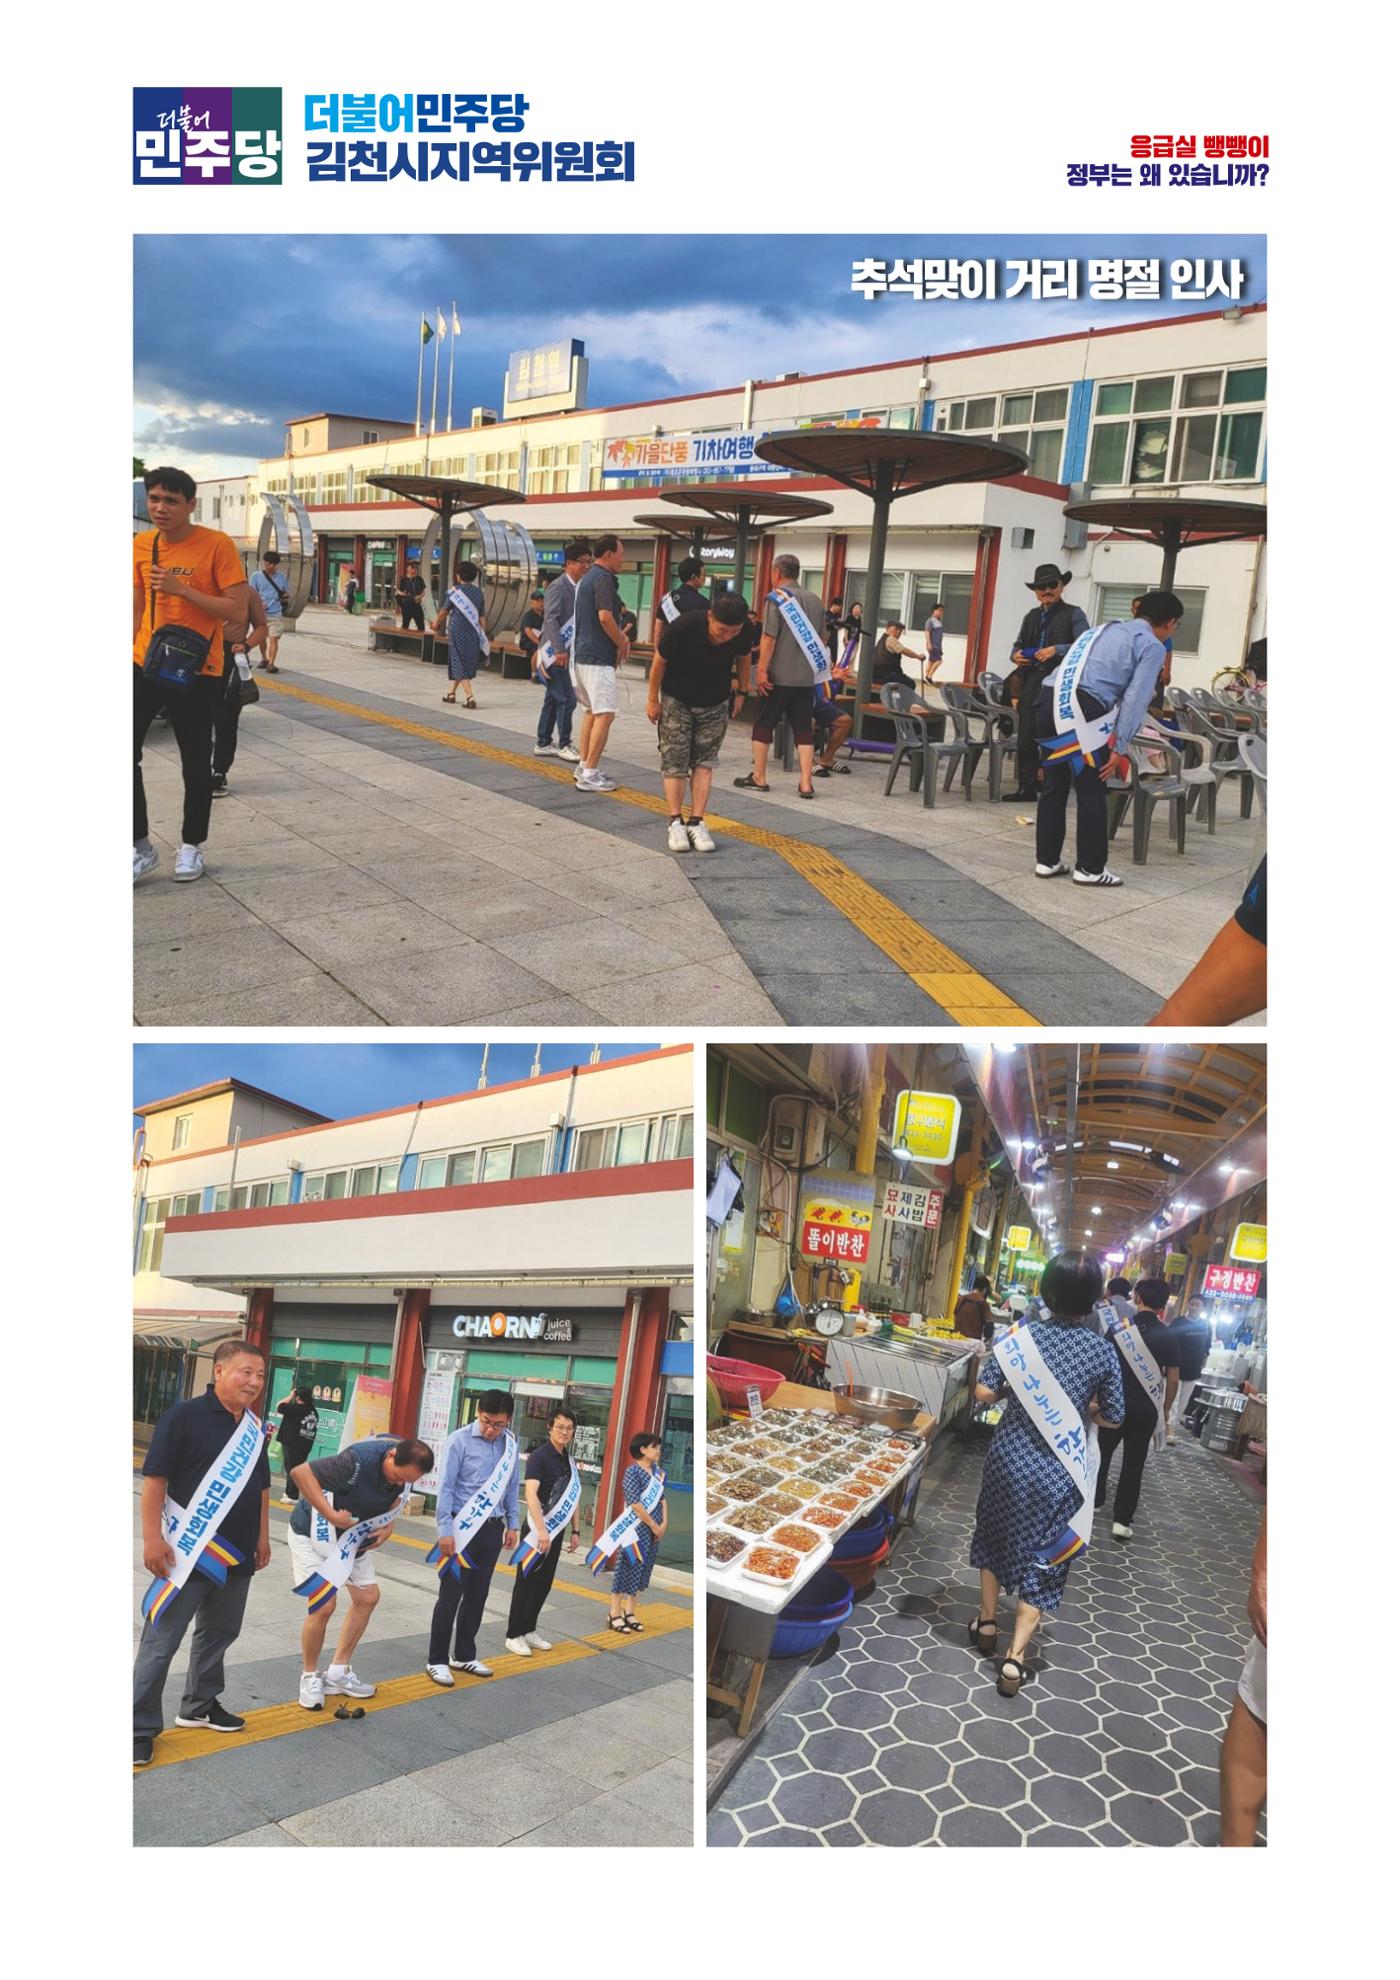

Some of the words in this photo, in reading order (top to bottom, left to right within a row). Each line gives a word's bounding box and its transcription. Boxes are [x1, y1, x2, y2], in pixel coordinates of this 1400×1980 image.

[635, 438, 689, 465] 가을단풍
[693, 435, 755, 462] 기차여행
[807, 643, 827, 672] 민생회
[1059, 666, 1078, 721] 민생회복
[884, 1189, 899, 1218] 묘사
[898, 1191, 913, 1220] 제사
[912, 1194, 927, 1222] 김밥
[927, 1194, 941, 1225] 주문
[807, 1228, 865, 1258] 똘이반찬
[453, 1312, 538, 1339] CHAORN
[544, 1331, 572, 1341] coffee
[547, 1319, 571, 1331] juice
[1003, 1337, 1027, 1372] 희망
[1023, 1373, 1064, 1427] 나누는
[220, 1425, 259, 1484] 국민건강
[177, 1480, 231, 1556] 민생회복
[459, 1491, 494, 1532] 한가위
[547, 1499, 574, 1534] 민생회
